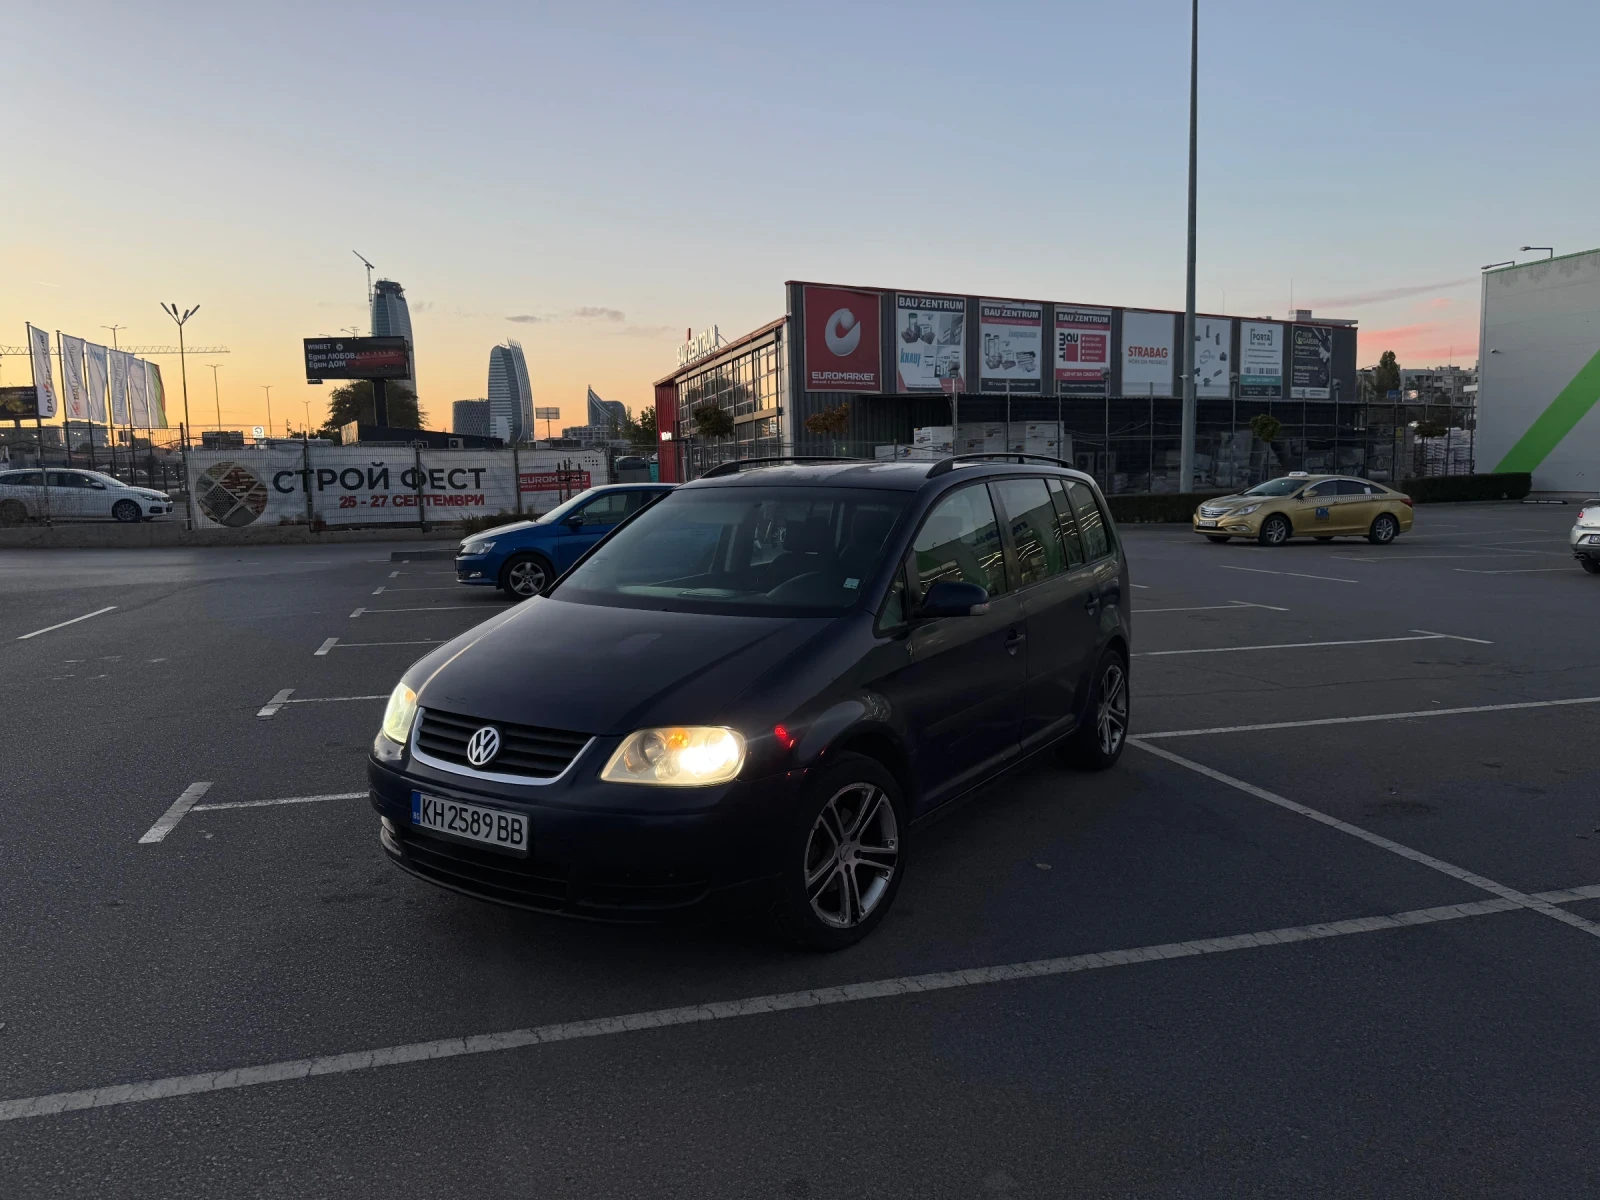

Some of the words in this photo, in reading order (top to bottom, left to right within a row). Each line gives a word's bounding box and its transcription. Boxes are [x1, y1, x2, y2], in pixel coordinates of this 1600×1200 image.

[899, 299, 918, 309] BAU
[920, 301, 964, 312] ZENTRUM
[984, 308, 1001, 316] BAU
[1002, 310, 1039, 319] ZENTRUM
[1058, 313, 1074, 321] BAU
[1074, 315, 1108, 323] ZENTRUM
[308, 353, 327, 362] Една
[327, 352, 356, 360] ЛЮБОВ
[1128, 345, 1168, 358] STRABAG
[309, 361, 327, 370] Един
[328, 360, 347, 369] ДОМ
[812, 371, 875, 381] EUROMARKET
[273, 462, 389, 493] СТРОЙ
[400, 466, 487, 491] ФЕСТ
[339, 495, 358, 508] 25
[372, 495, 388, 508] 27
[392, 494, 485, 508] СЕПТЕМВРИ
